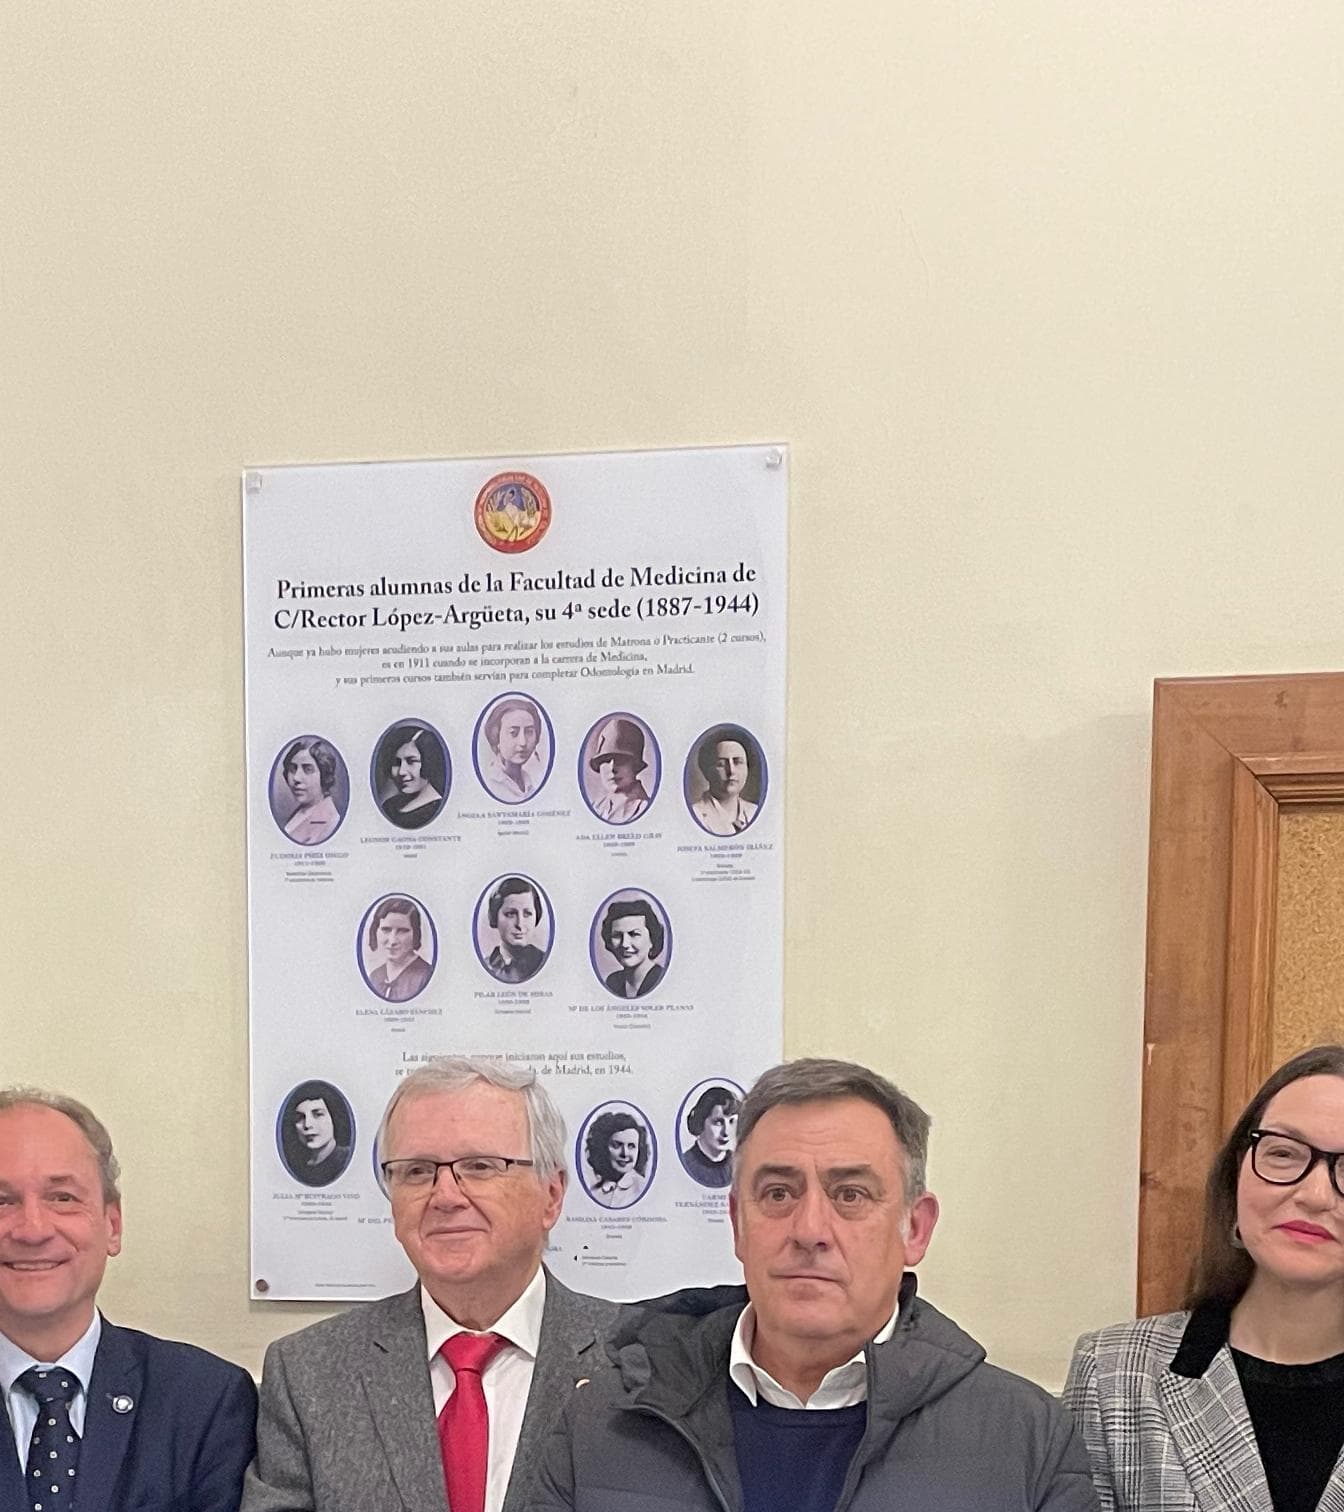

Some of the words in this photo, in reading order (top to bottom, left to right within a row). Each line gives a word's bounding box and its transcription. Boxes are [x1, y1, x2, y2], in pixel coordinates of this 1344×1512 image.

[278, 579, 365, 599] Primeras
[370, 577, 452, 595] alumnas
[458, 574, 480, 593] de
[485, 572, 503, 592] la
[510, 569, 595, 591] Facultad
[602, 569, 624, 587] de
[631, 566, 727, 587] Medicina
[733, 562, 756, 582] de
[274, 609, 366, 629] C/Rector
[372, 604, 530, 632] López-Argüeta,
[535, 605, 556, 620] su
[562, 603, 582, 619] 4ª
[588, 599, 631, 618] sede
[637, 593, 759, 620] (1887-1944)
[268, 647, 303, 658] Aunque
[319, 646, 340, 656] hubo
[345, 647, 379, 658] mujeres
[383, 644, 429, 655] acudiendo
[456, 642, 478, 652] aulas
[482, 644, 501, 655] para
[556, 637, 593, 649] estudios
[611, 636, 651, 648] Matrona
[663, 633, 714, 646] Practicante
[408, 658, 429, 668] 1911
[433, 657, 465, 668] cuando
[481, 656, 530, 669] incorporan
[474, 671, 506, 681] servían
[509, 670, 528, 683] para
[532, 669, 577, 682] completar
[402, 1052, 418, 1062] Las
[556, 1064, 593, 1076] Madrid,
[609, 1064, 633, 1075] 1944.
